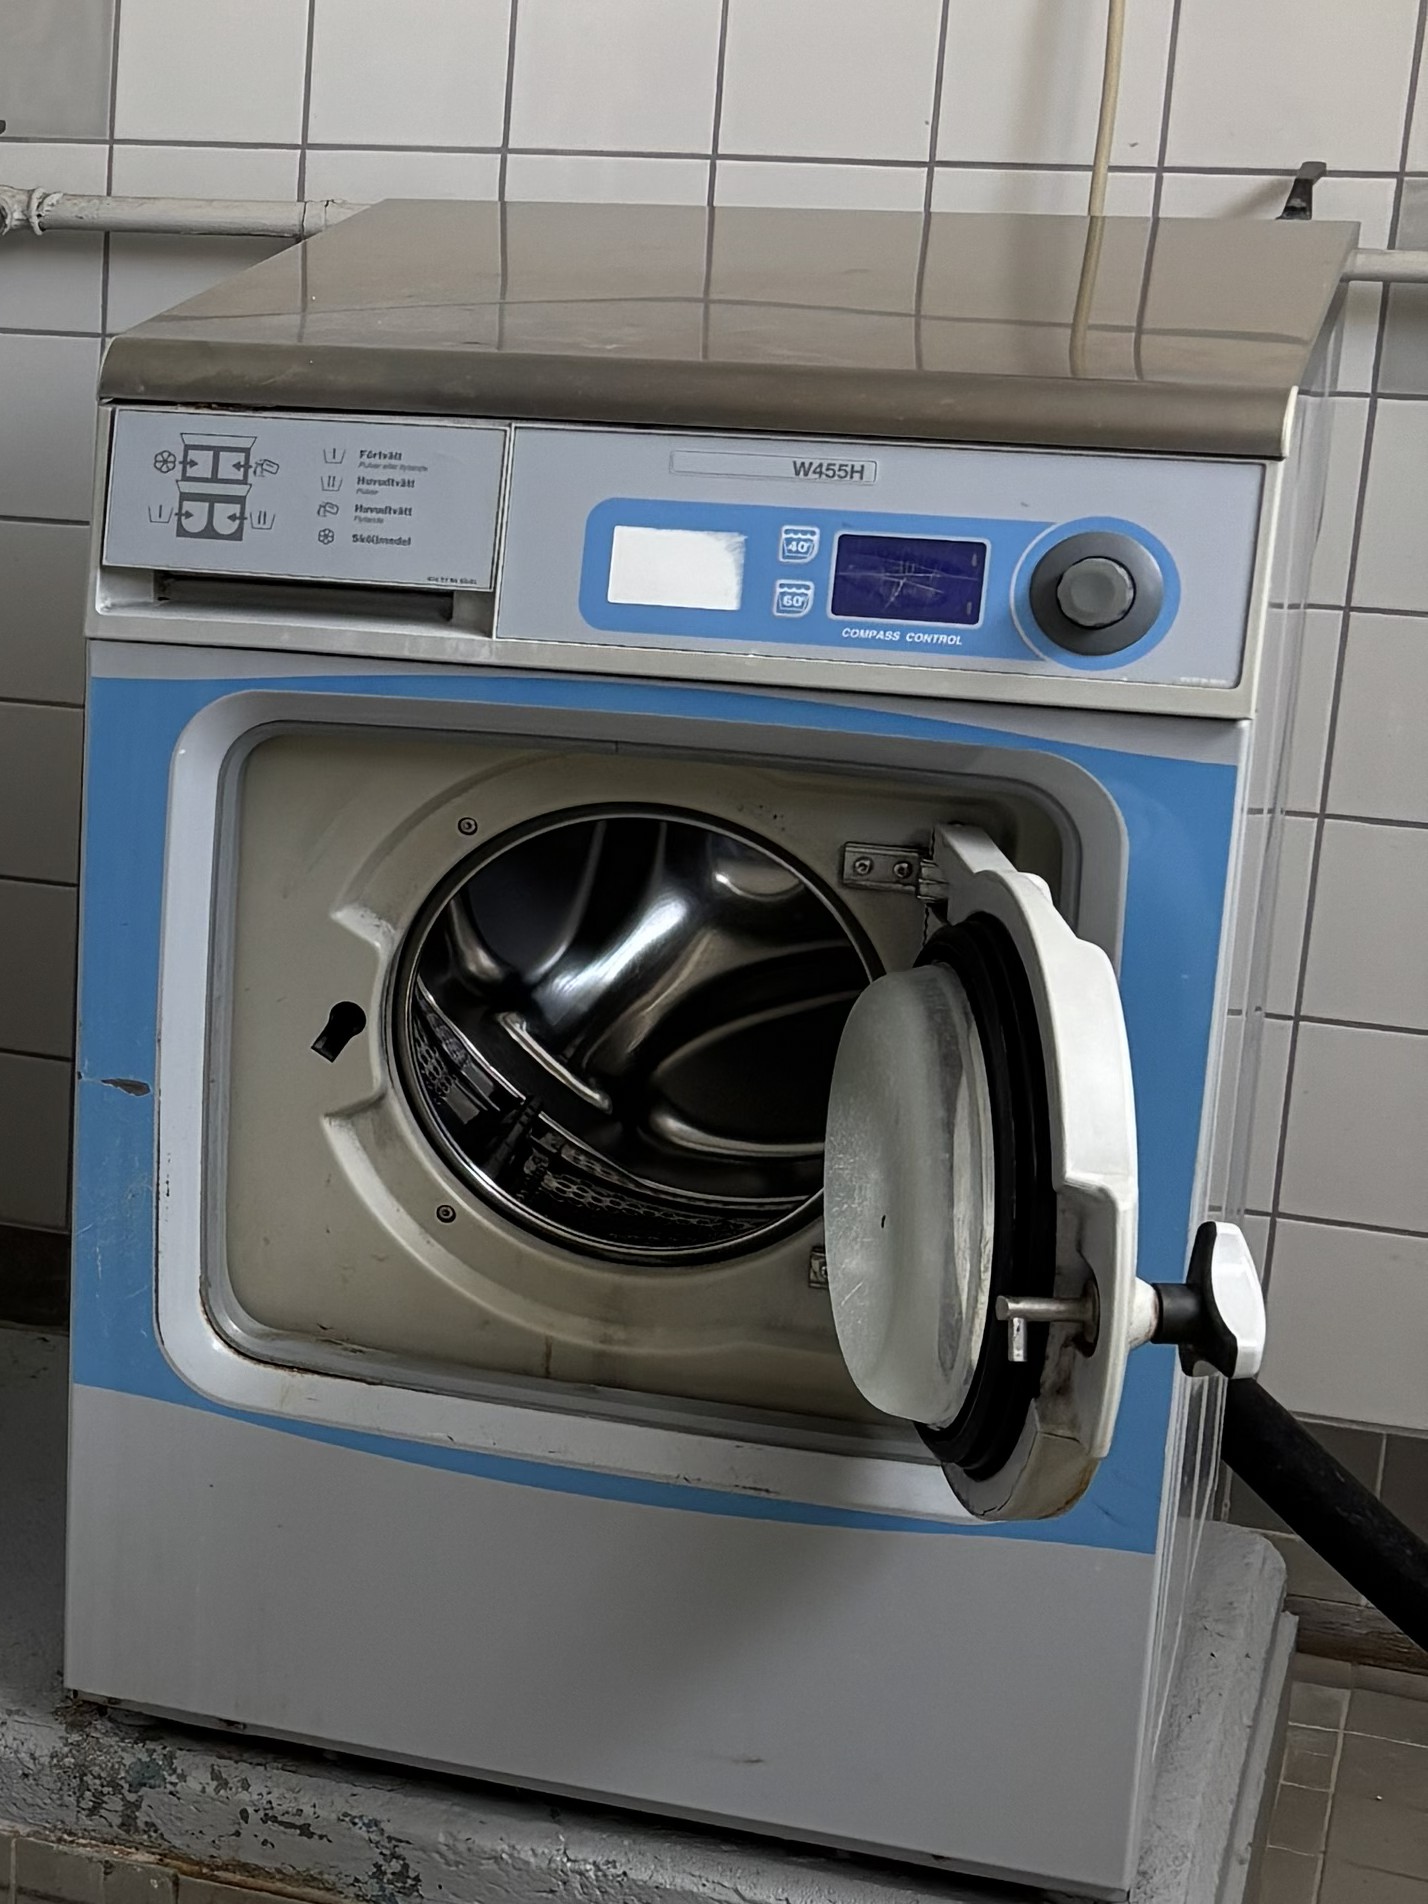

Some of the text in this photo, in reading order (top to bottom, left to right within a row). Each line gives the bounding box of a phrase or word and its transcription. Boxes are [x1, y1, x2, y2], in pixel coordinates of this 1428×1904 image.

[792, 460, 865, 481] W455H
[841, 627, 963, 646] COMPASS CONTROL
